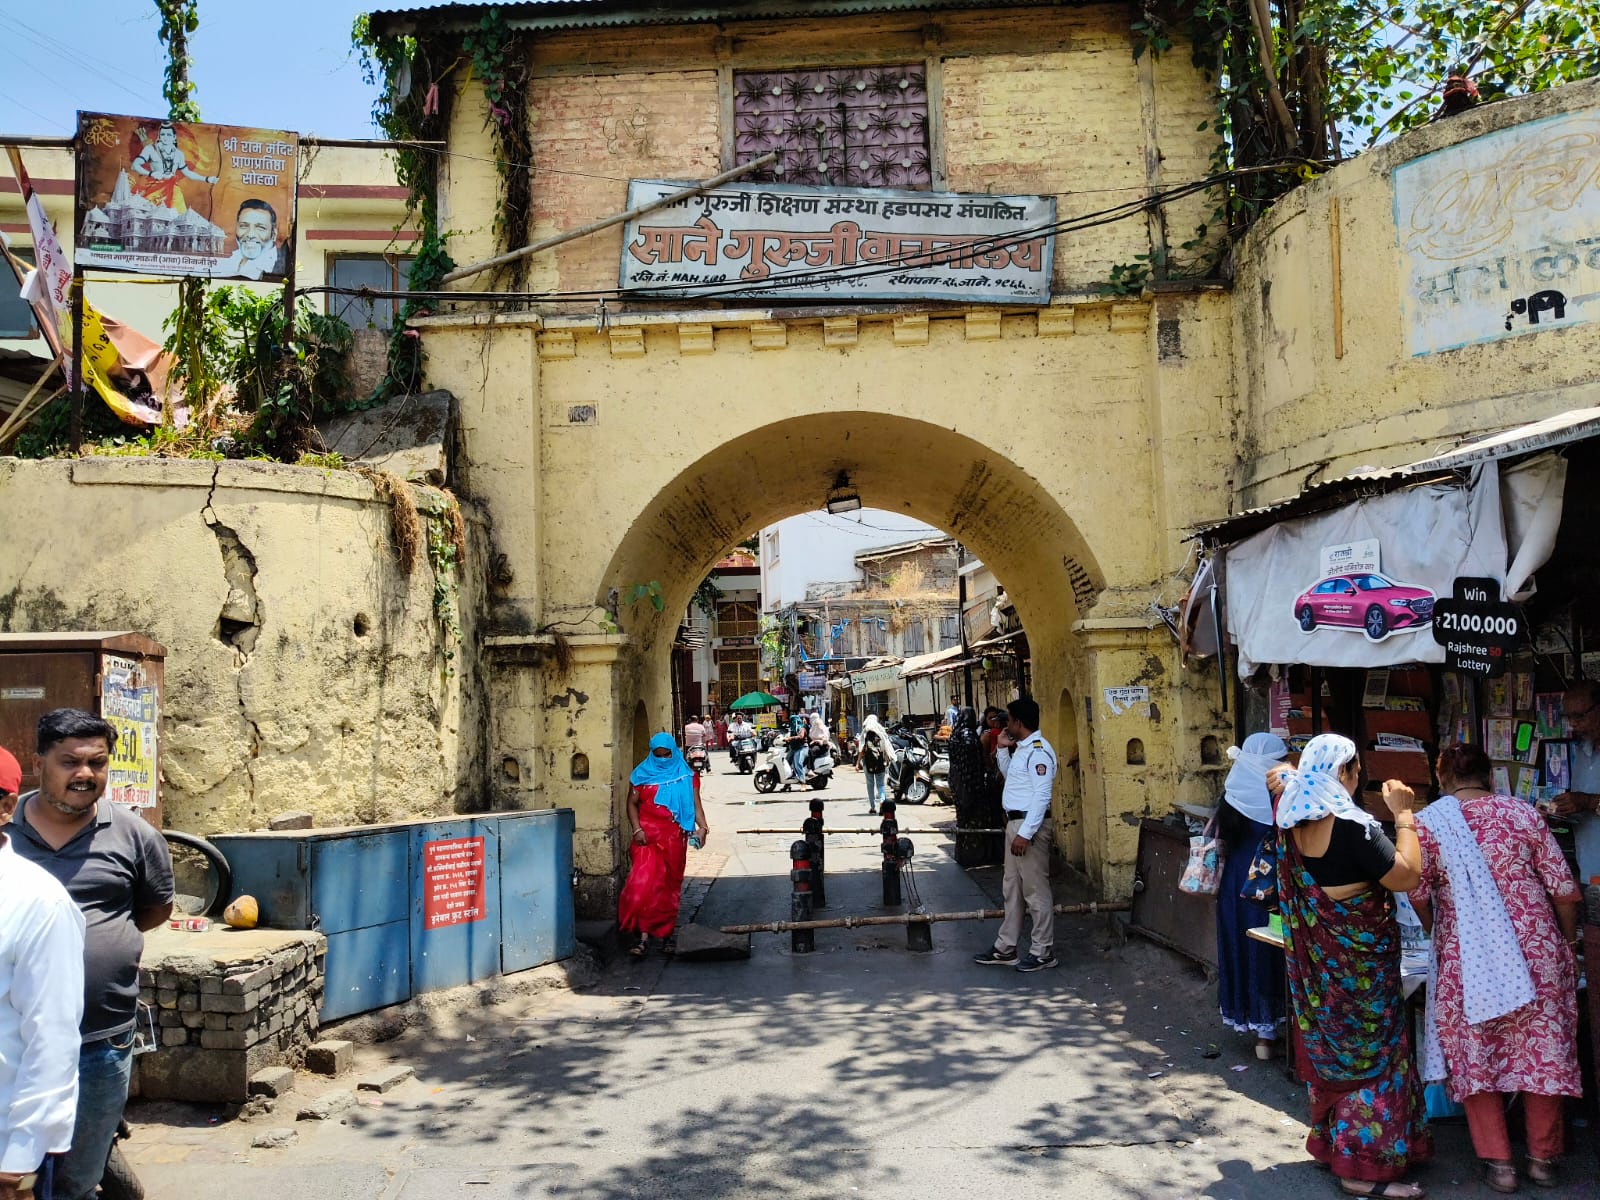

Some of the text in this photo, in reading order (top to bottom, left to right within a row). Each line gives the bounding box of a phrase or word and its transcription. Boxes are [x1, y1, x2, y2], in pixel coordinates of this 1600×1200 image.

[224, 136, 294, 156] श्री राम मंदिर
[241, 170, 279, 187] सोहळा
[757, 193, 820, 217] शिक्षण
[826, 194, 878, 216] संस्था
[882, 201, 954, 220] हडपसर
[628, 216, 724, 266] साने
[859, 230, 1047, 272] वाचनालय
[1463, 586, 1487, 602] Win
[1447, 641, 1488, 656] Rajshree
[1457, 657, 1491, 674] Lottery
